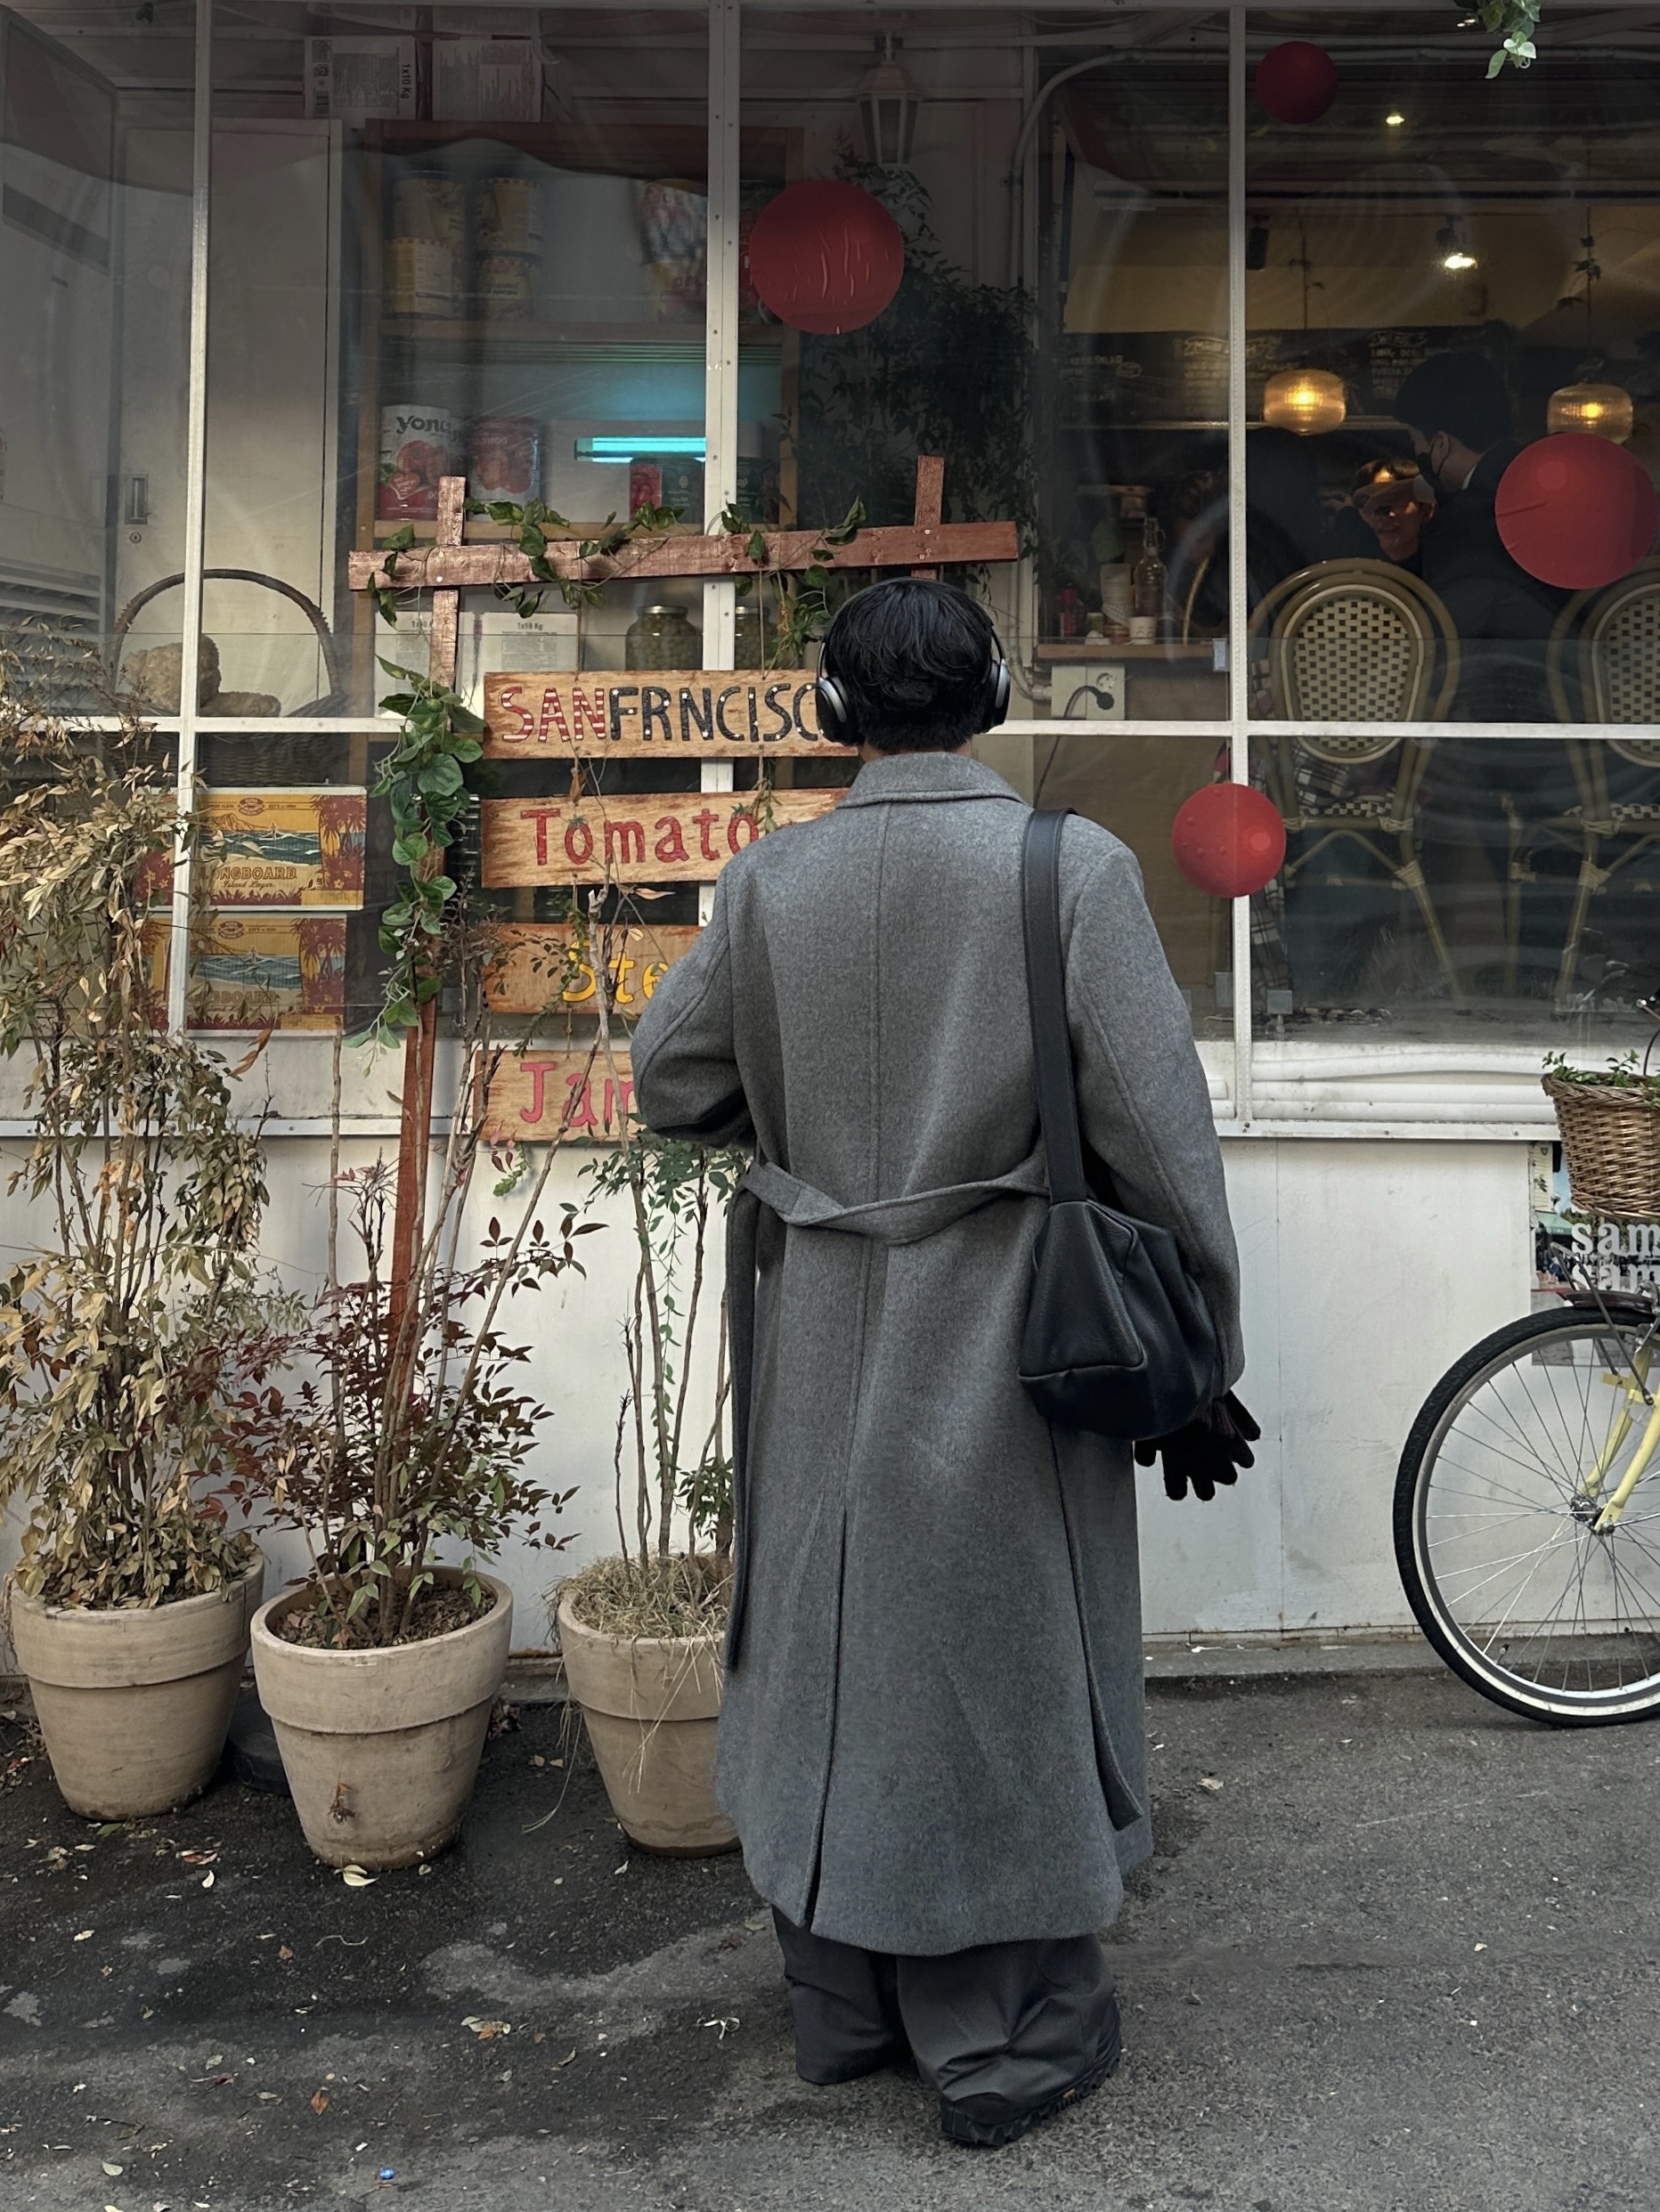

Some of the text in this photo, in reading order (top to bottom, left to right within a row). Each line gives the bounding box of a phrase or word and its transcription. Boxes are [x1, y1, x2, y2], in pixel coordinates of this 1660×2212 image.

[402, 63, 411, 85] 1x10
[500, 683, 821, 743] SANFRNCISC
[520, 805, 760, 866] Tomato
[200, 866, 298, 880] LNGBOARD
